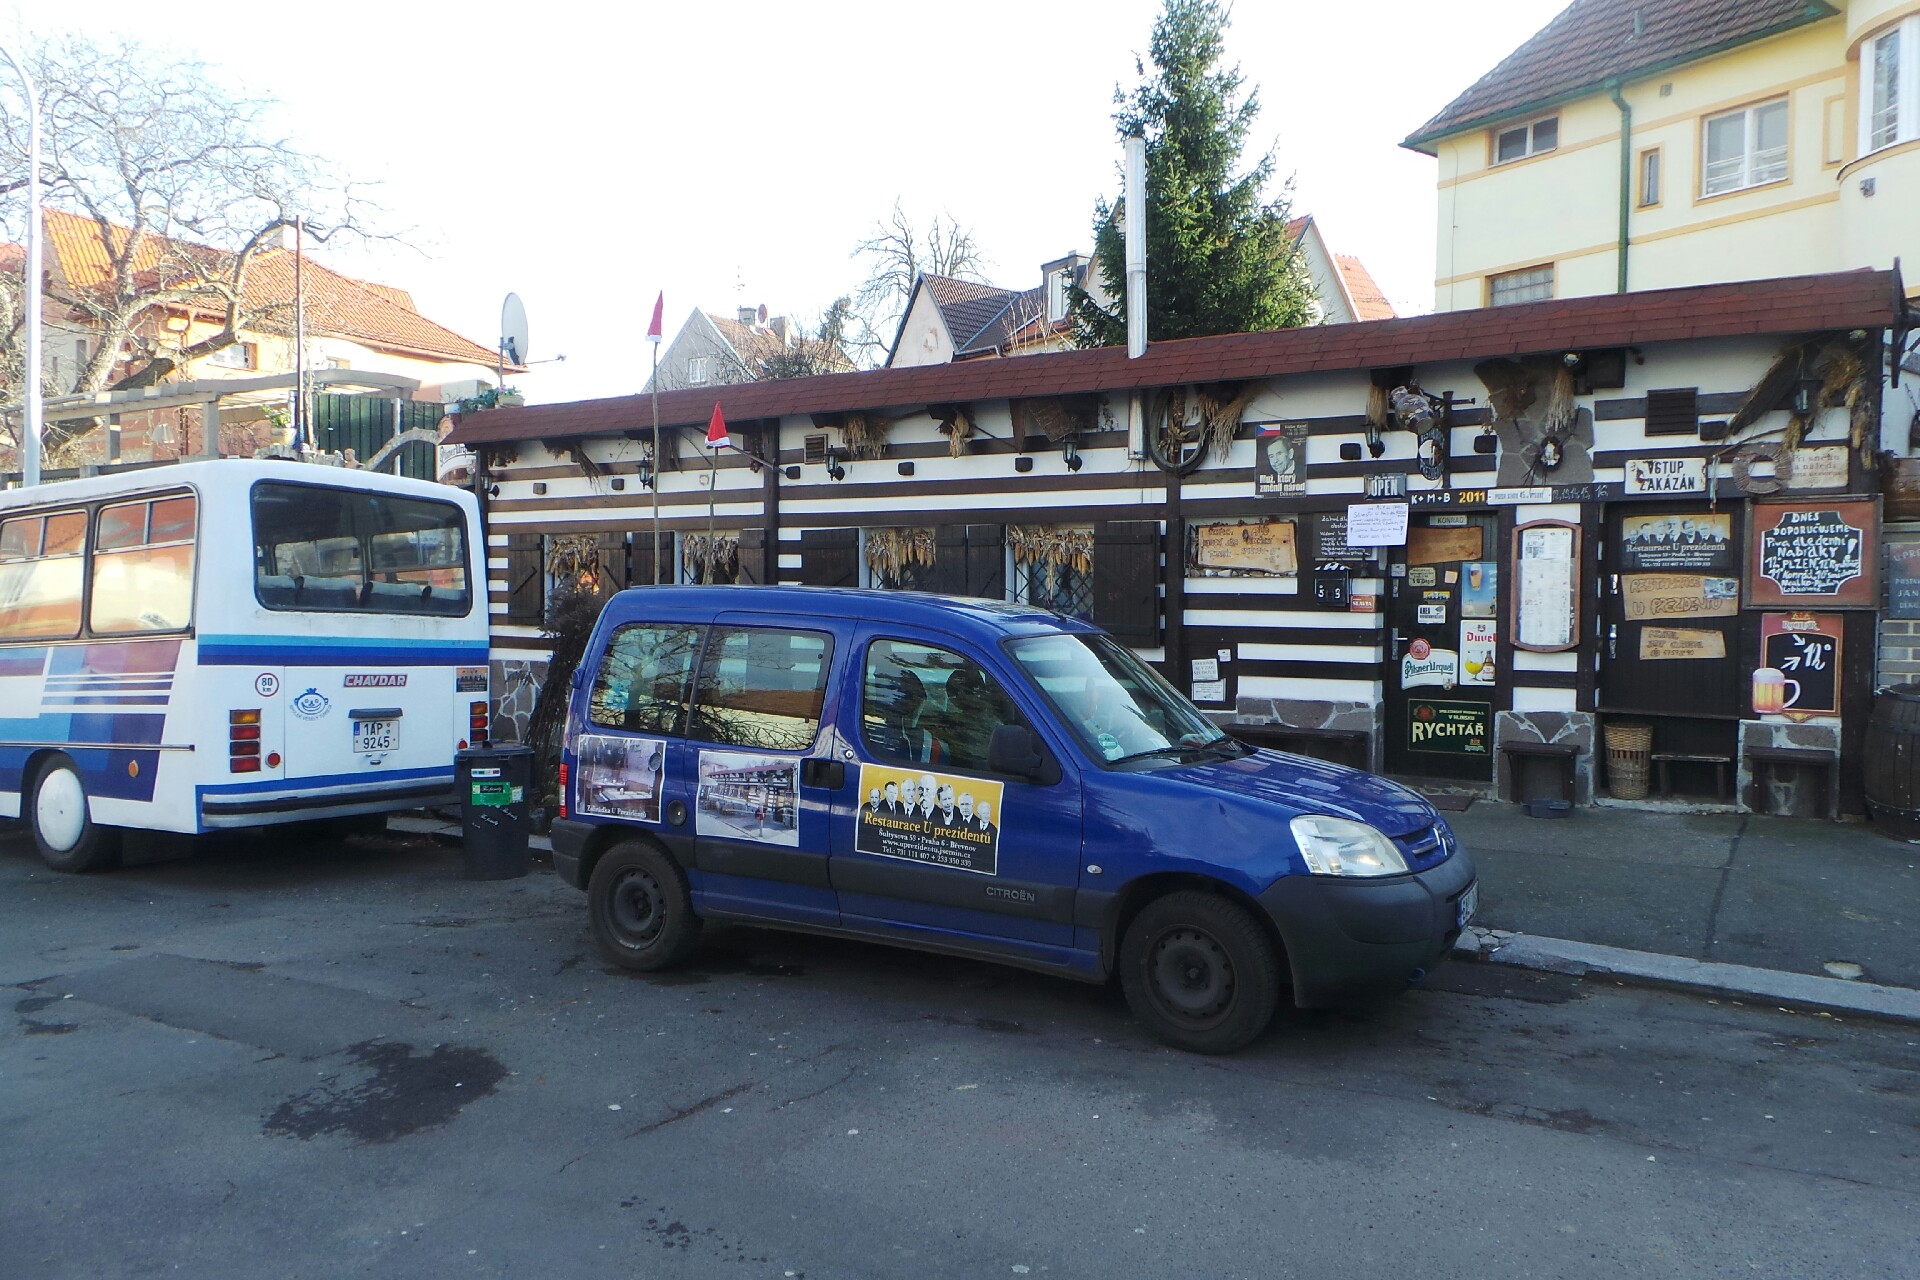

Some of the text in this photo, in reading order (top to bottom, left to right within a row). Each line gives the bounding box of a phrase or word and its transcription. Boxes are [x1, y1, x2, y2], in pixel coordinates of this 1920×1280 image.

[1648, 461, 1684, 474] VSTUP
[1278, 473, 1296, 484] který
[1640, 474, 1695, 490] ZAKÁZÁN
[1260, 482, 1305, 492] změnil národ
[1371, 478, 1398, 496] OPEN
[1459, 491, 1486, 503] 2011
[1791, 512, 1819, 523] DNES
[1773, 523, 1850, 535] DOPORUČUJEME
[1682, 543, 1726, 552] prezidentů
[1632, 602, 1645, 615] U
[1467, 632, 1498, 642] Duvel
[1405, 660, 1454, 678] Pilsner Urquell
[261, 677, 273, 687] 80
[345, 675, 406, 687] CHAVDAR
[363, 722, 383, 736] 1AP
[1412, 721, 1484, 743] RYCHTÁŘ
[363, 736, 390, 749] 9245
[864, 812, 991, 844] Restaurace U prezidentů
[921, 836, 940, 846] Praha
[897, 848, 906, 856] 731
[986, 886, 1035, 902] CITROËN
